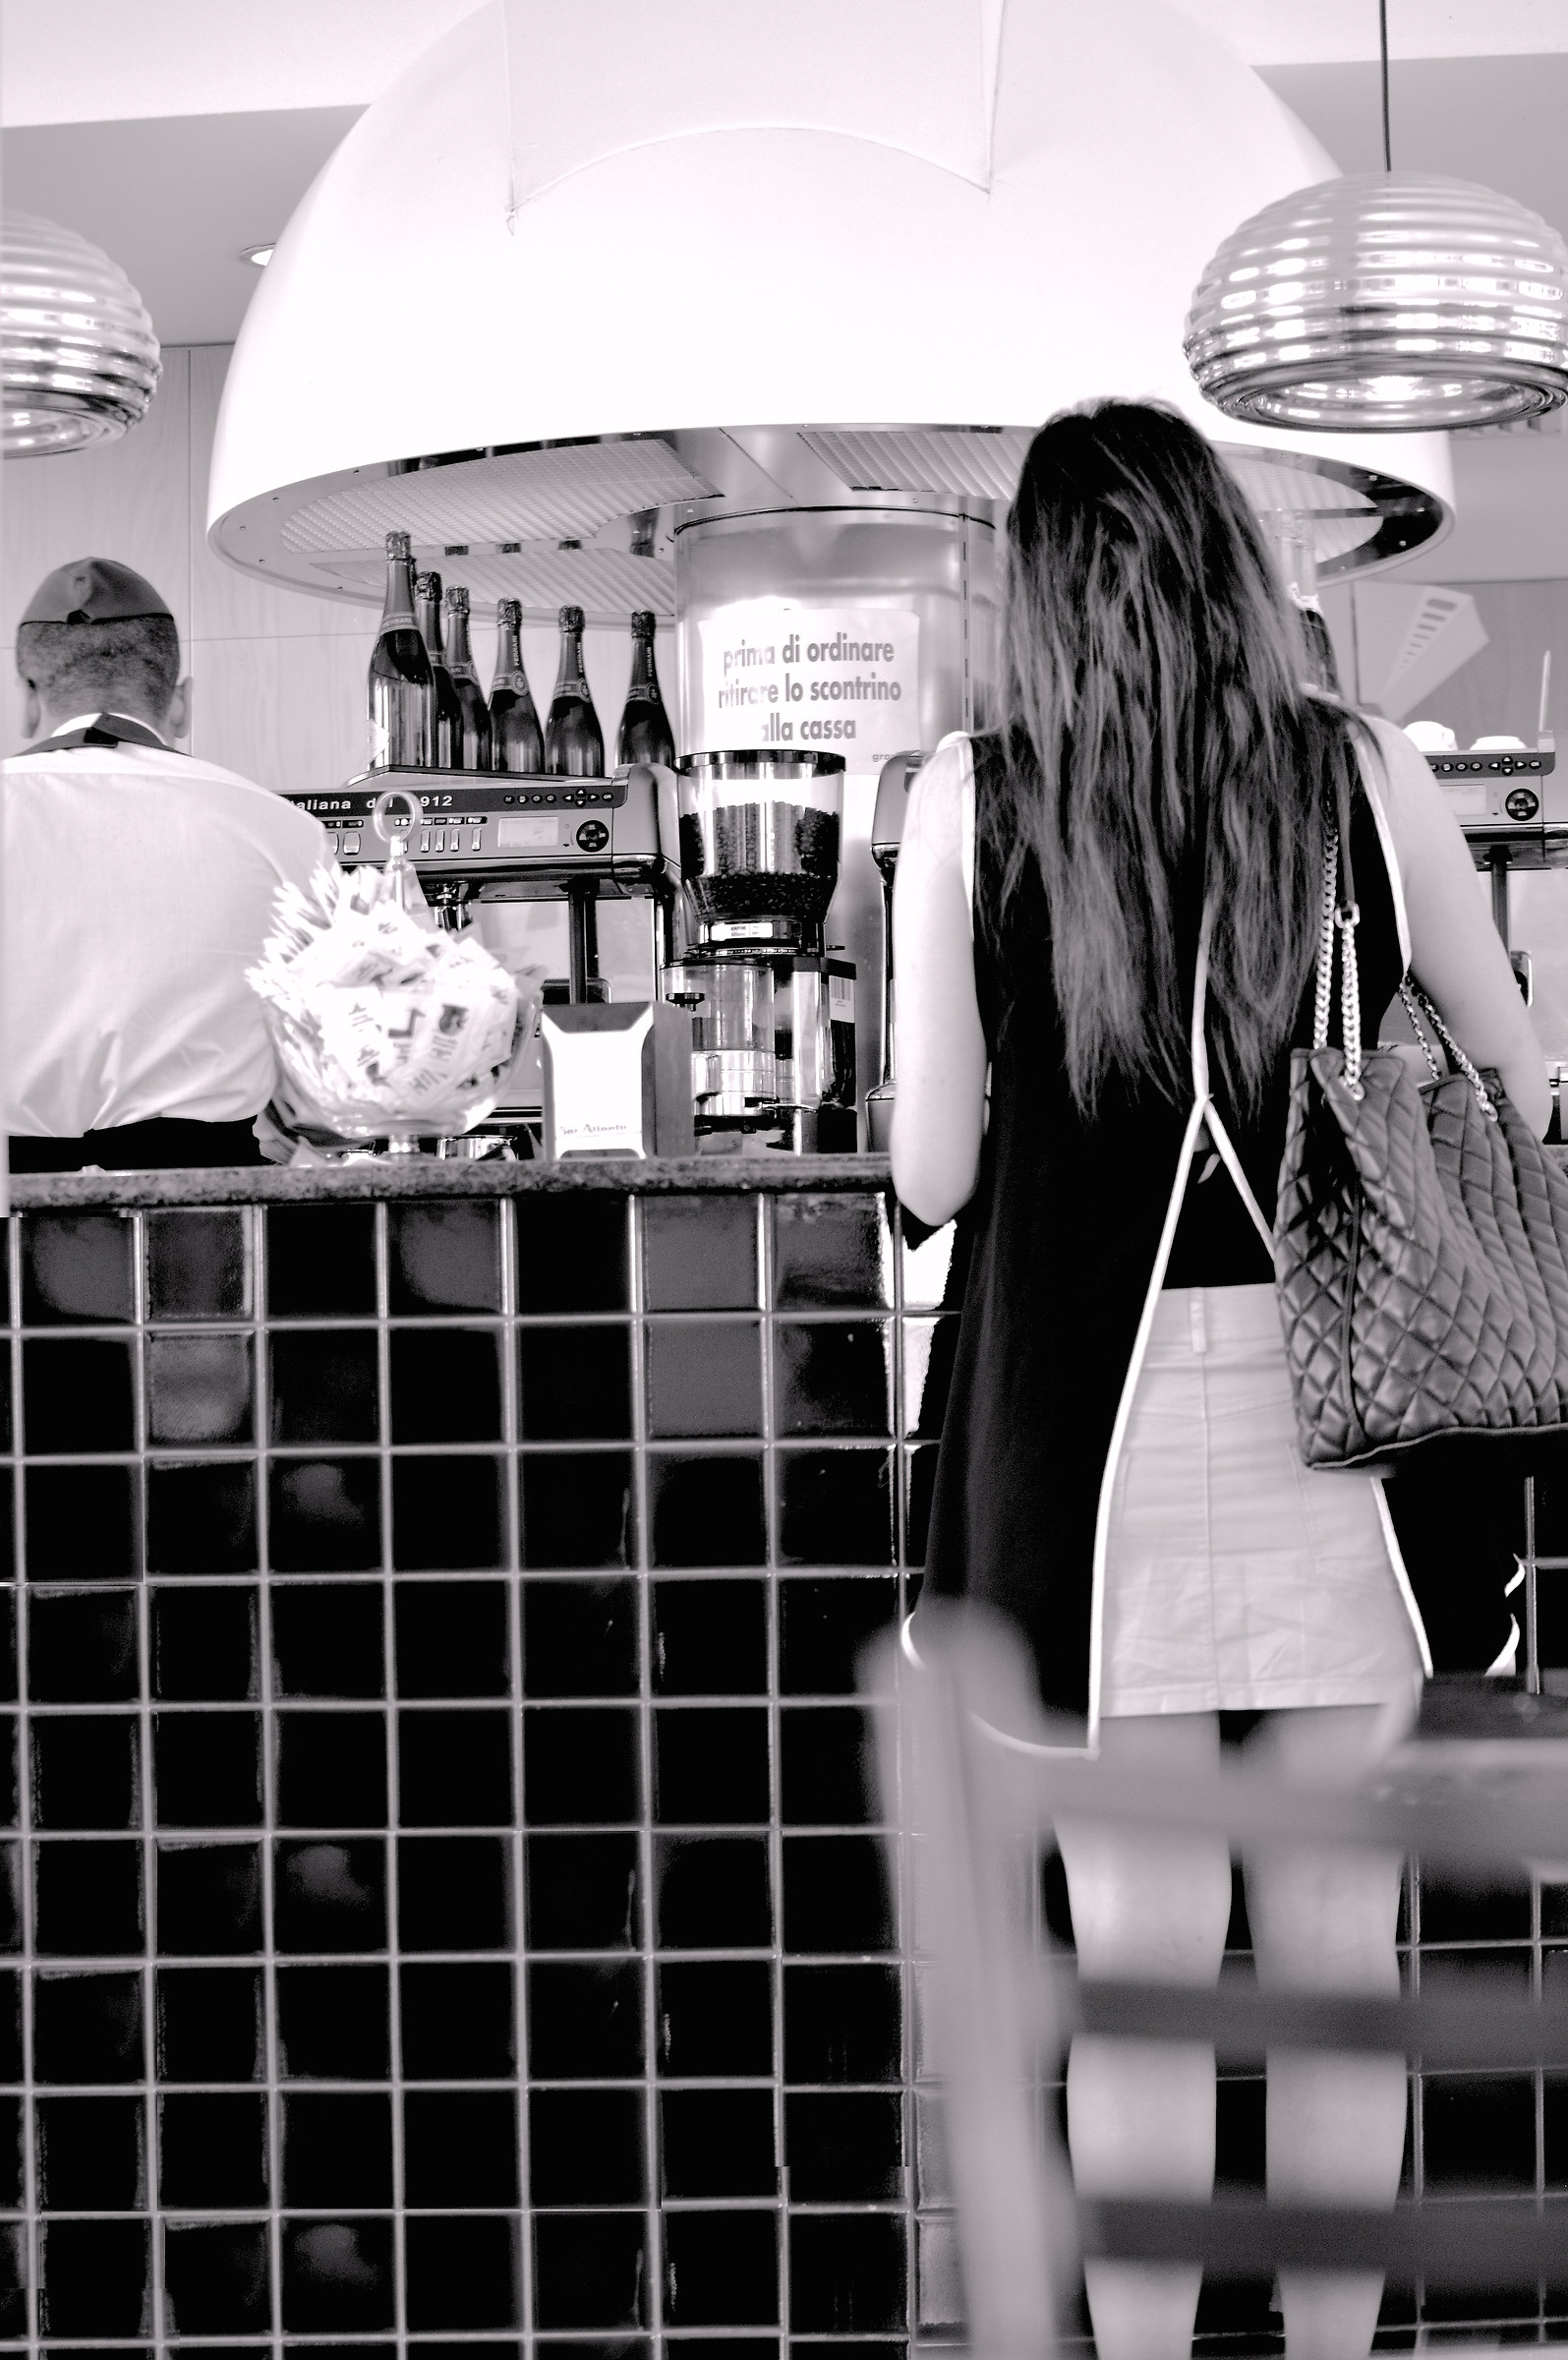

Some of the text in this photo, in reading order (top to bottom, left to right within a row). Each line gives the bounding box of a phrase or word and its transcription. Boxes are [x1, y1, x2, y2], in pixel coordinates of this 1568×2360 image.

[724, 632, 895, 677] prima di ordinare
[719, 672, 901, 708] ritirare lo scontrino
[761, 712, 856, 741] alla cassa
[289, 798, 351, 810] aliana
[419, 796, 453, 807] 912
